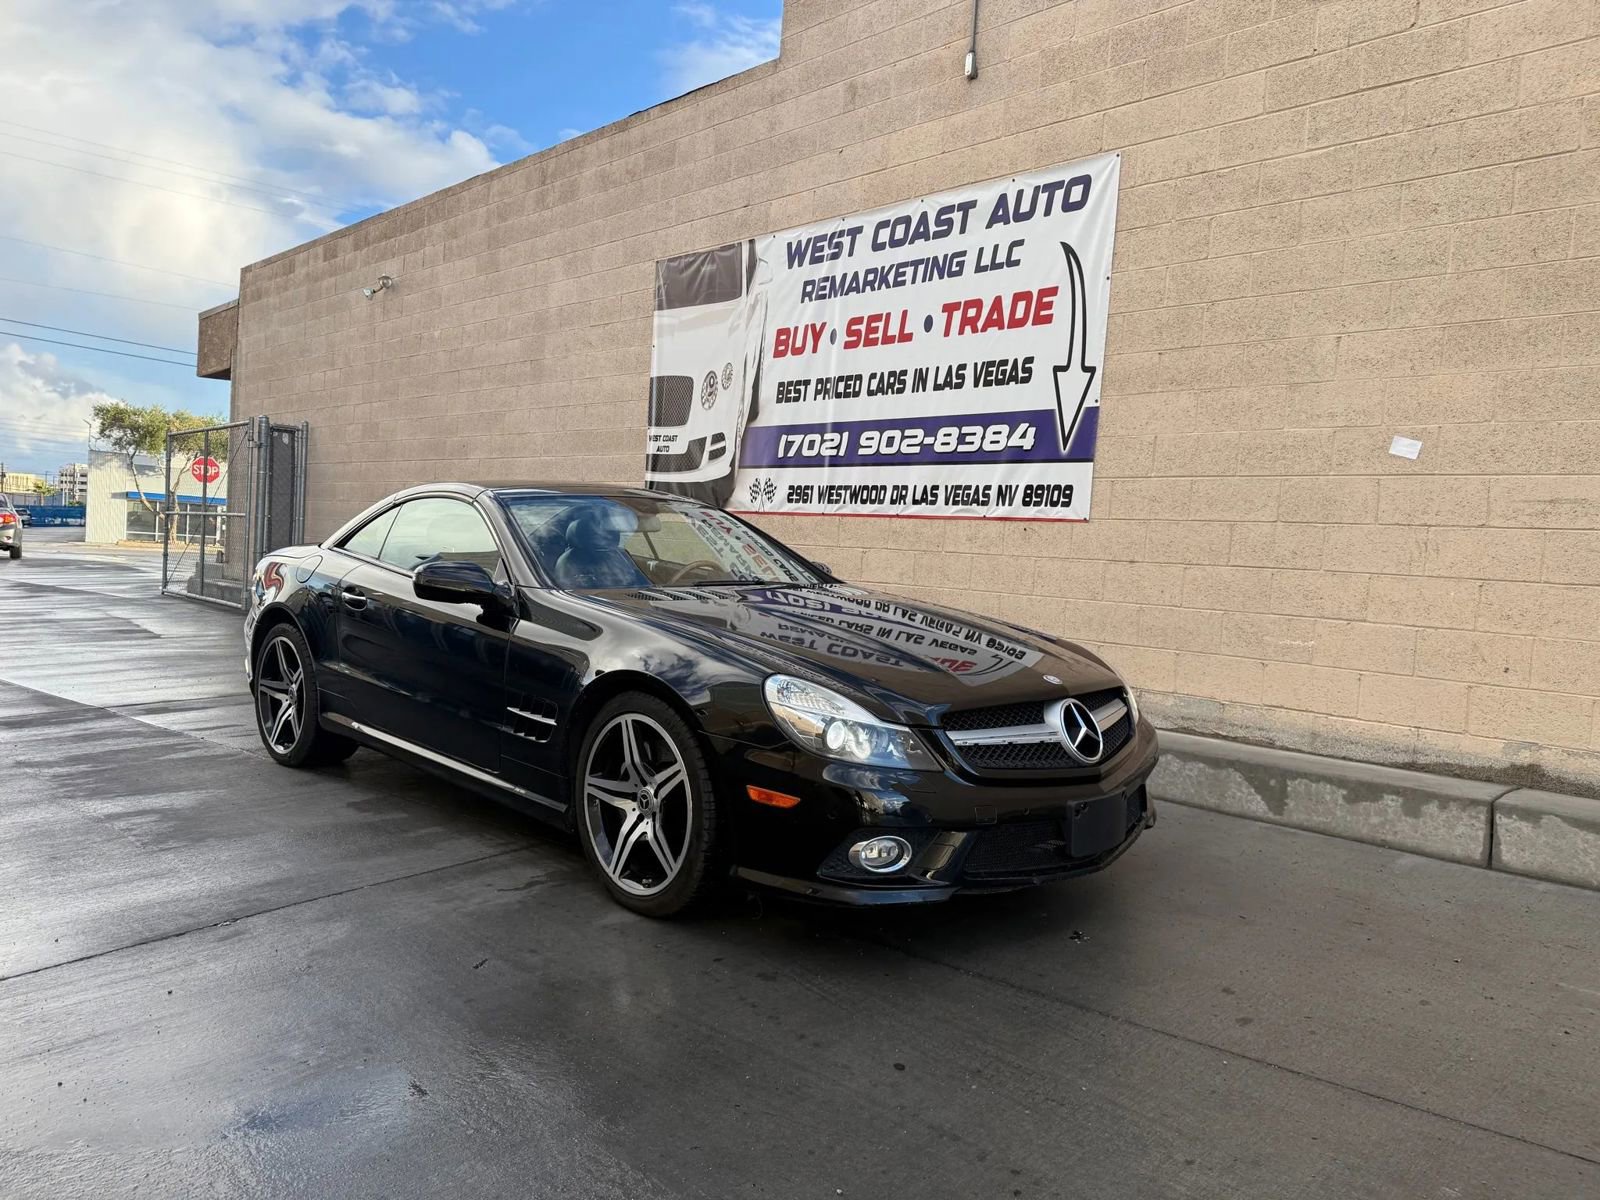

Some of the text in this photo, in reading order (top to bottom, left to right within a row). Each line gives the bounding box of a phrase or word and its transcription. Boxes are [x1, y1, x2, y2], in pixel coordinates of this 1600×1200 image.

[786, 174, 1092, 270] WEST COAST AUTO
[800, 238, 1025, 304] REMARKETING LLC
[772, 285, 1060, 359] BUY SELL TRADE
[776, 356, 1035, 404] BEST PRICED CARS IN LAS VEGAS
[656, 445, 670, 453] AUTO
[662, 434, 678, 442] COAST
[858, 423, 1037, 455] 902-8384
[787, 484, 1074, 507] 2961 WESTWOOD DR LAS VEGAS NV 89109
